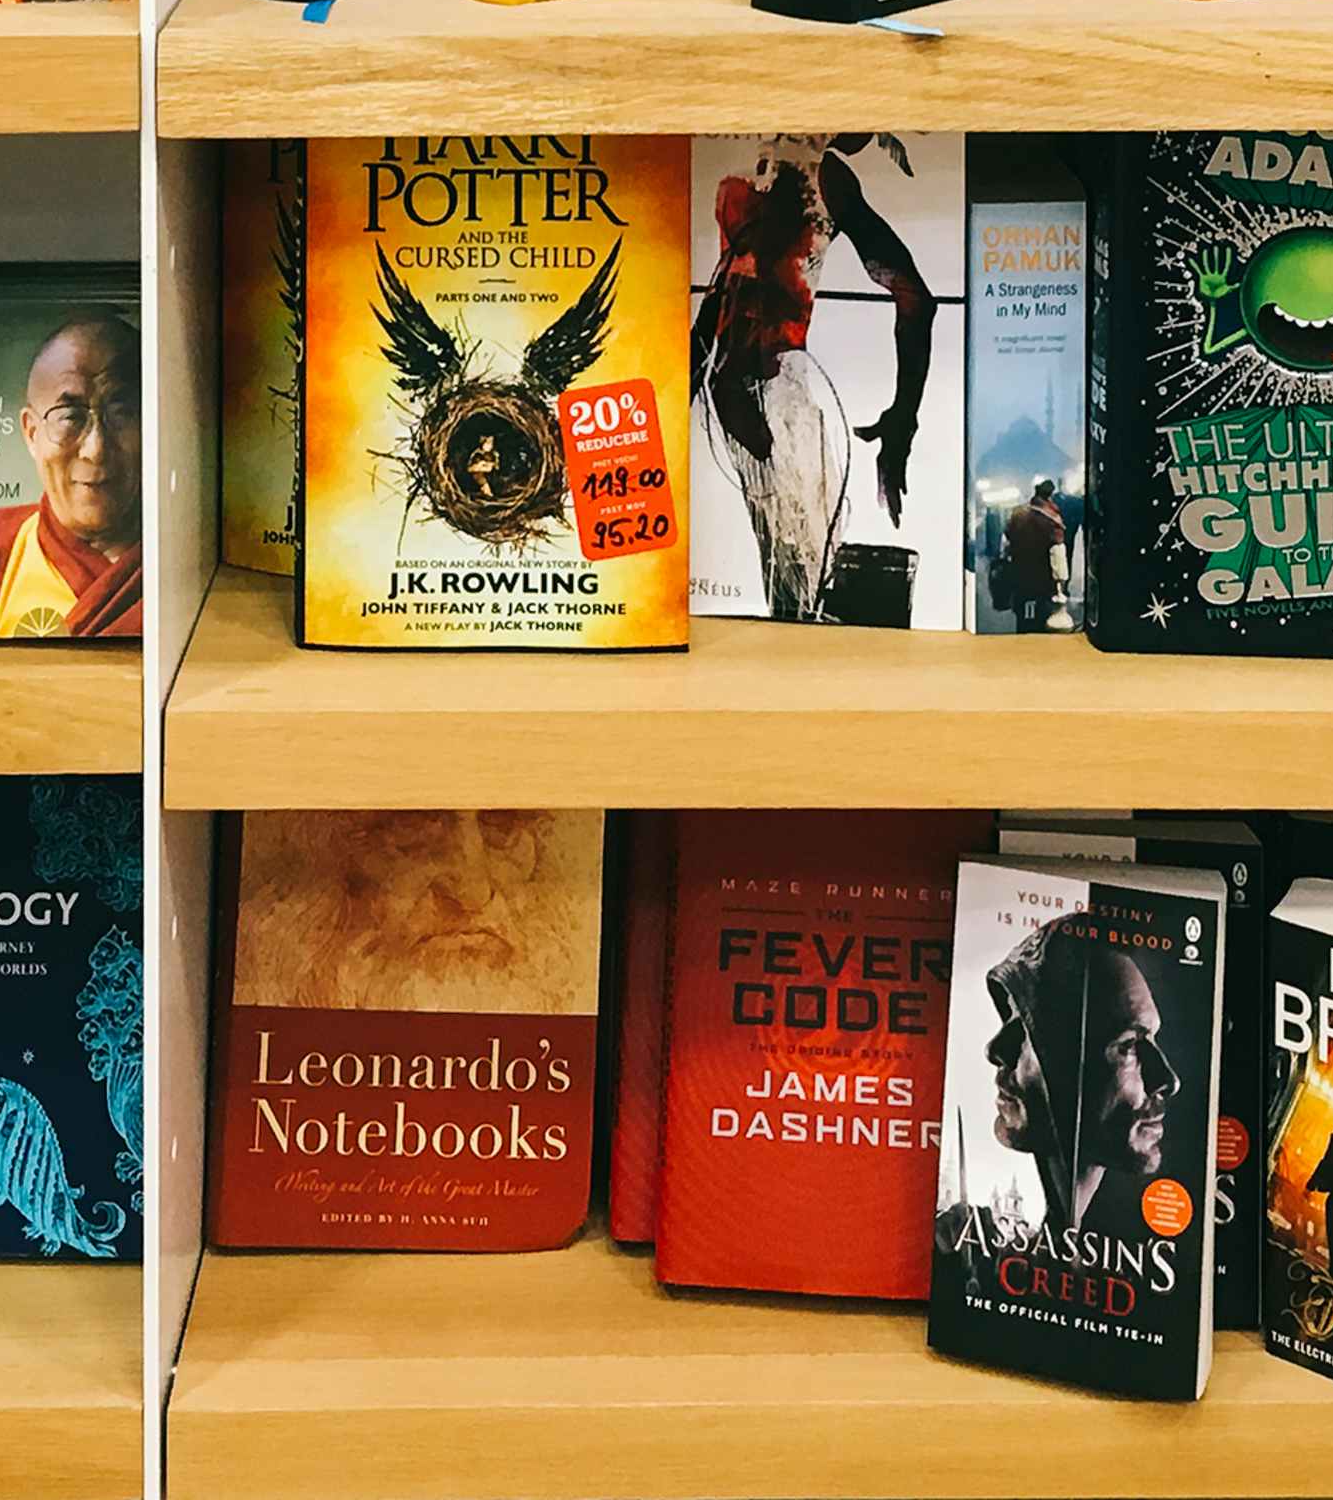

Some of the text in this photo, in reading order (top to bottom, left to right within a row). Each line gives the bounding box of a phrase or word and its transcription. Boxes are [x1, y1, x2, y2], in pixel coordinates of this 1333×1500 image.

[363, 163, 628, 232] POTTER
[985, 281, 1078, 299] A Strangeness
[997, 302, 1066, 319] in My Mind
[569, 393, 648, 436] 20%
[576, 431, 649, 452] REDUCERE
[388, 573, 598, 597] J.K. ROWLING
[252, 1031, 572, 1095] Leonardo's
[249, 1098, 569, 1161] Notebooks
[954, 1205, 1177, 1293] ASSASSIN'S
[999, 1258, 1135, 1317] CREED
